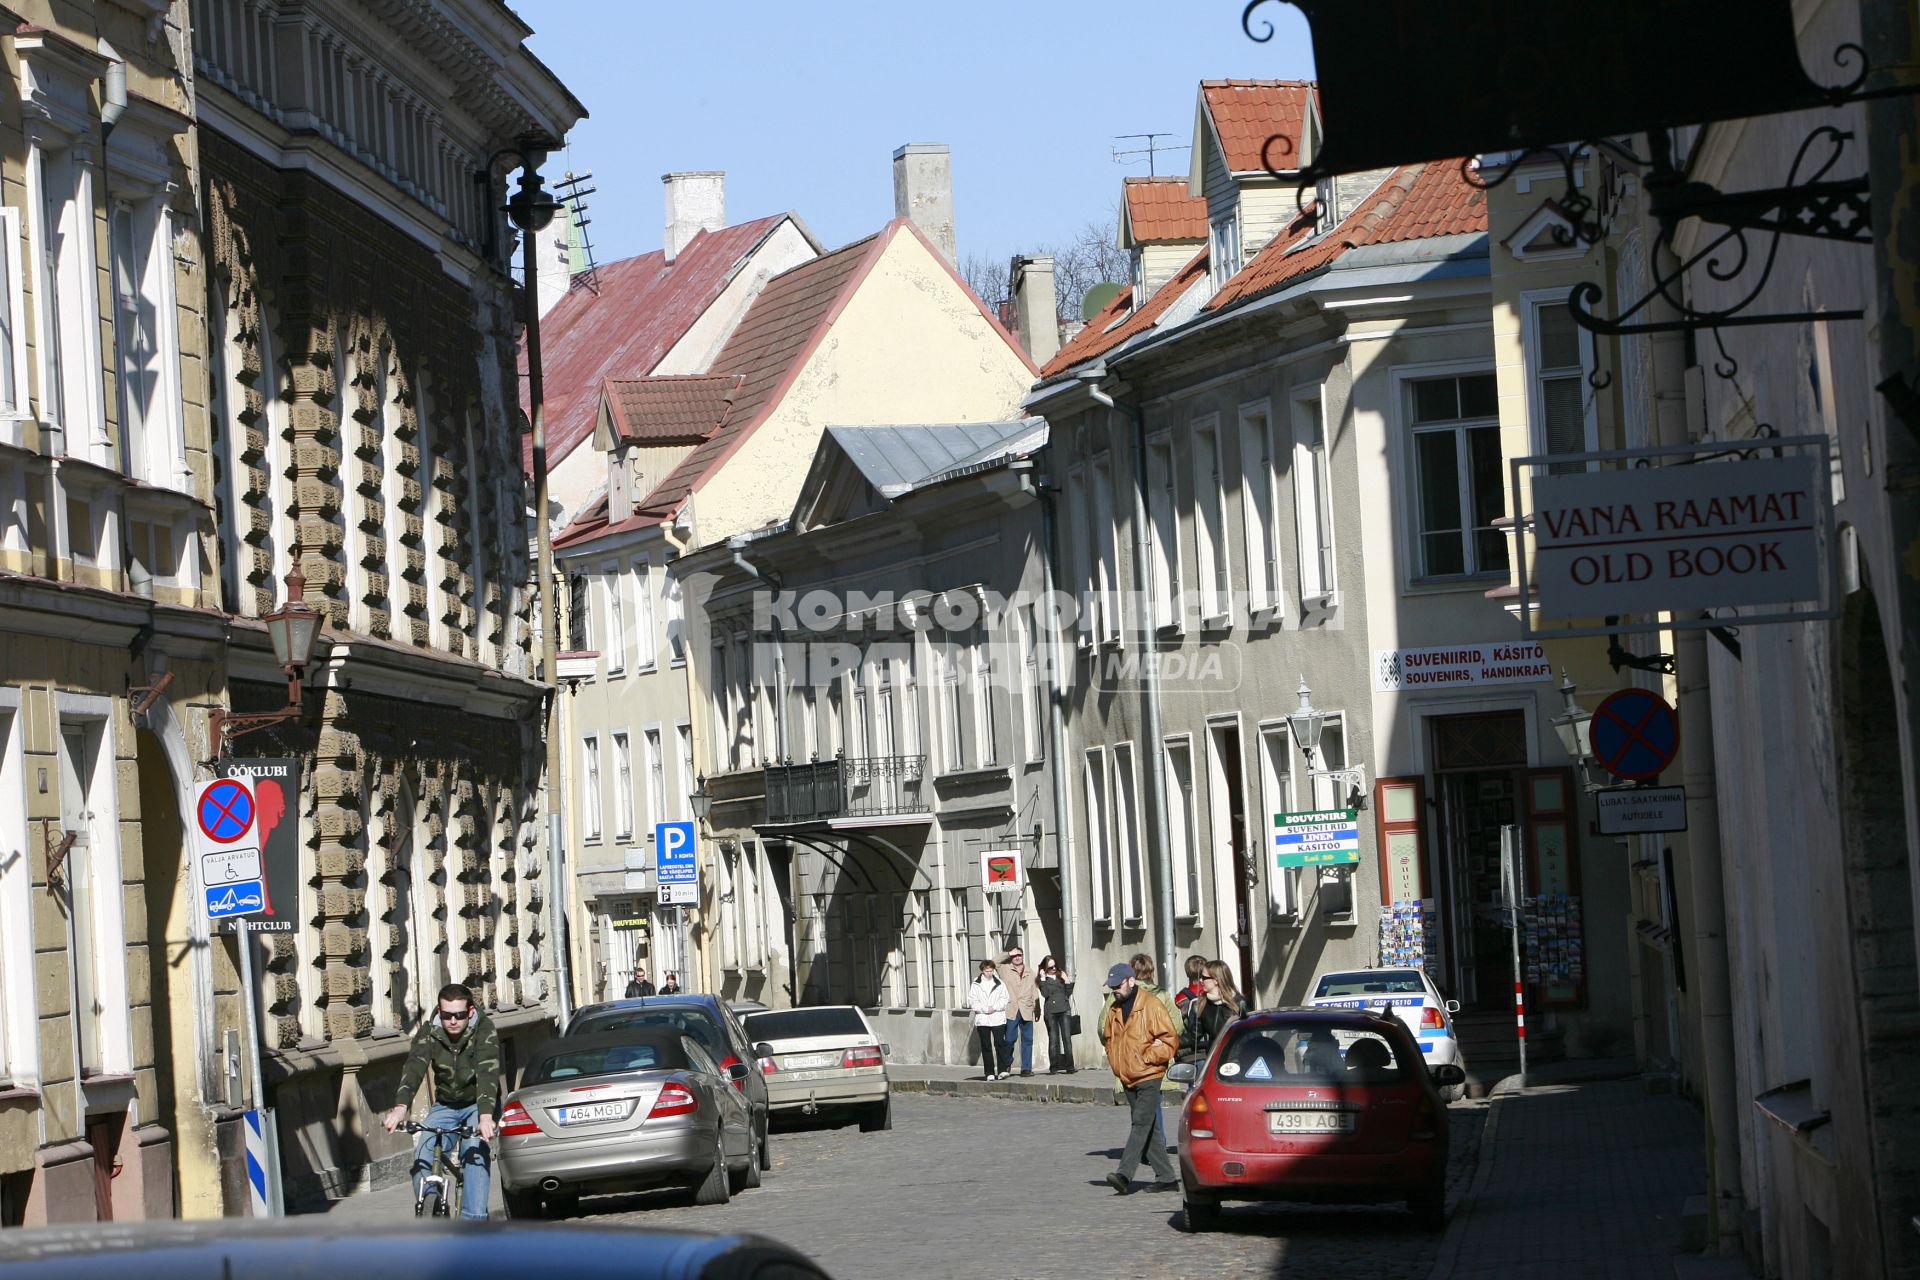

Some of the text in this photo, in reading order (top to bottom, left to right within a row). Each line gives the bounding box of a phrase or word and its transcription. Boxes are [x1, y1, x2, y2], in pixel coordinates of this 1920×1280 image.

[1542, 491, 1806, 539] VANA RAAMAT
[1570, 542, 1787, 586] OLD BOOK
[1405, 650, 1485, 667] SUVENIIRID,
[1406, 669, 1474, 684] SOUVENIRS,
[227, 765, 288, 778] ÖÖKLUBI
[1285, 812, 1347, 823] SOUVENIRS
[1287, 823, 1348, 834] SUVENIIRID
[664, 827, 686, 859] P
[1302, 832, 1334, 842] LINEN
[228, 921, 292, 931] NHTCLUB
[571, 1104, 623, 1120] 464 MGD
[1276, 1114, 1349, 1128] 439 AOE
